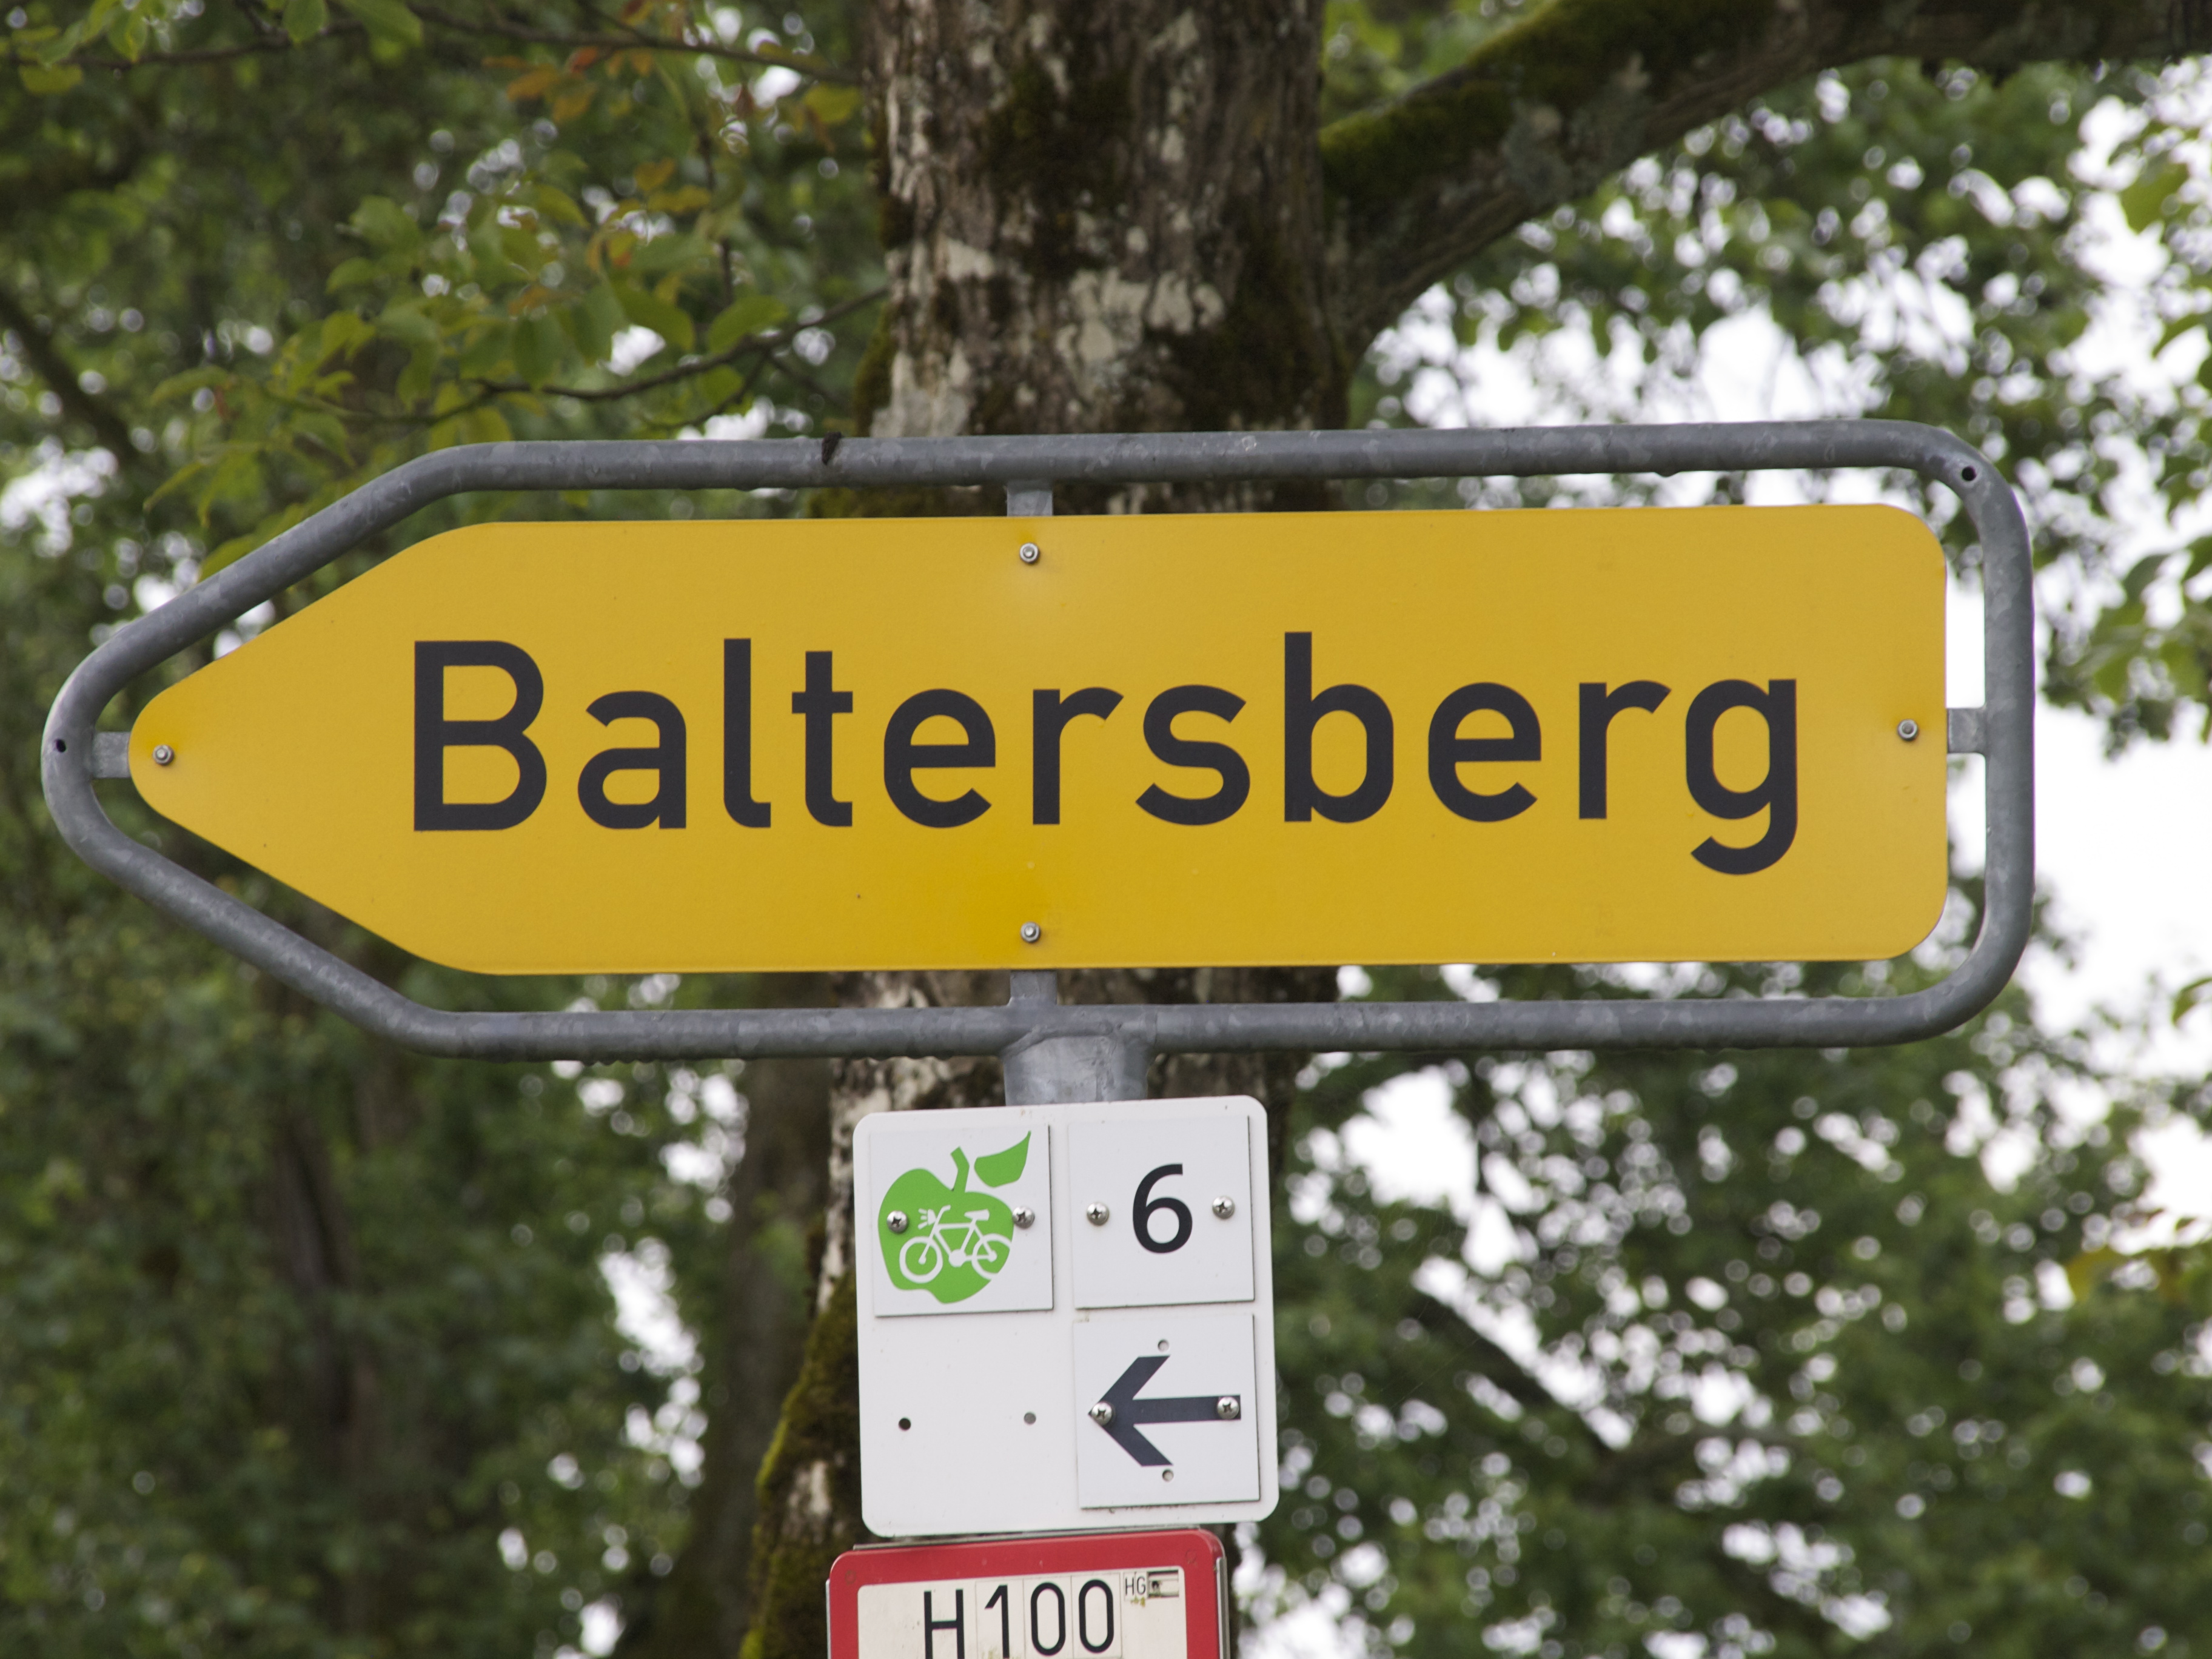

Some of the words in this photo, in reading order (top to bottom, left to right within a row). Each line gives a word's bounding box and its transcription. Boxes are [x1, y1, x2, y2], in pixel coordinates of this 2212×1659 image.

[414, 631, 1798, 876] Baltersberg
[1132, 1163, 1193, 1254] 6
[1124, 1576, 1147, 1597] HG
